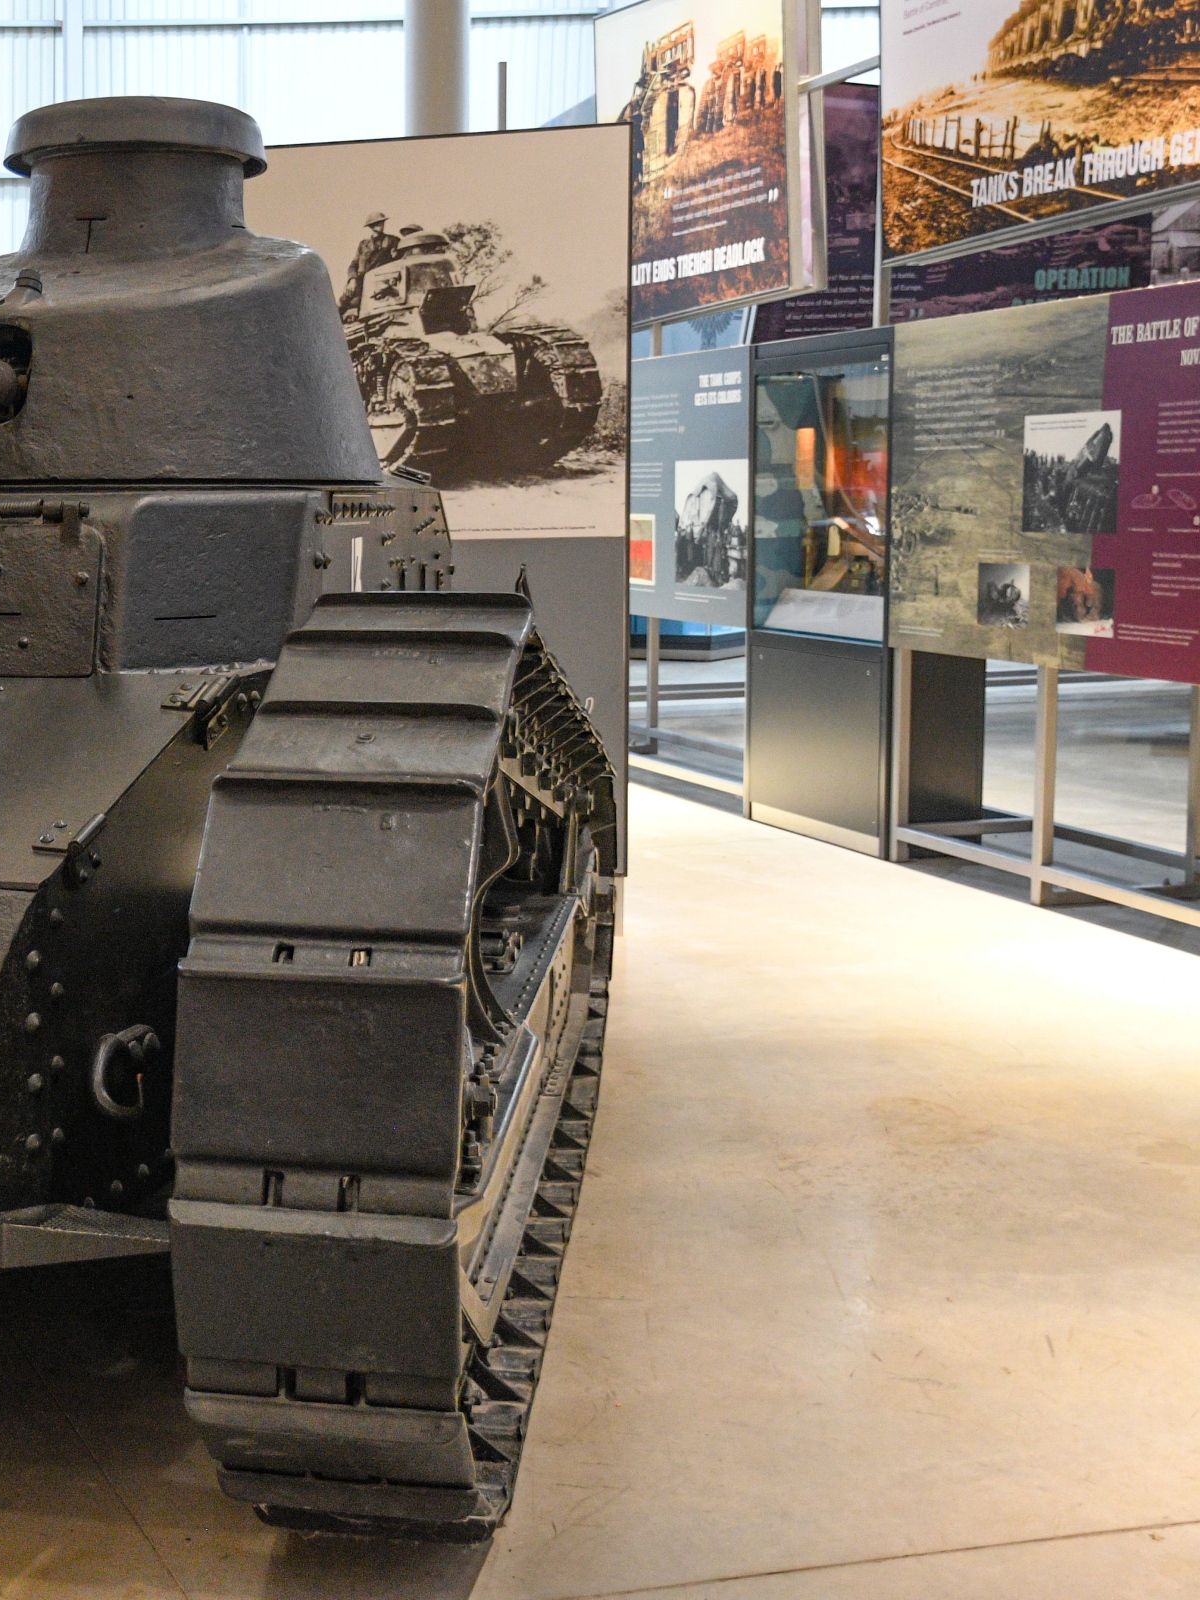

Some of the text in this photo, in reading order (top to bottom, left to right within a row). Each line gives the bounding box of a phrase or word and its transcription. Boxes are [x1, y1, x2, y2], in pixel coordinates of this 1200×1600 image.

[970, 170, 1019, 208] TANKS
[1022, 158, 1076, 198] BREAK
[1081, 136, 1166, 186] THROUGH
[652, 257, 676, 283] ENDS
[677, 249, 713, 279] TRENCH
[714, 236, 766, 272] DEADLOCK
[1034, 266, 1132, 291] OPERATION
[1110, 315, 1200, 346] THE BATTLE OF
